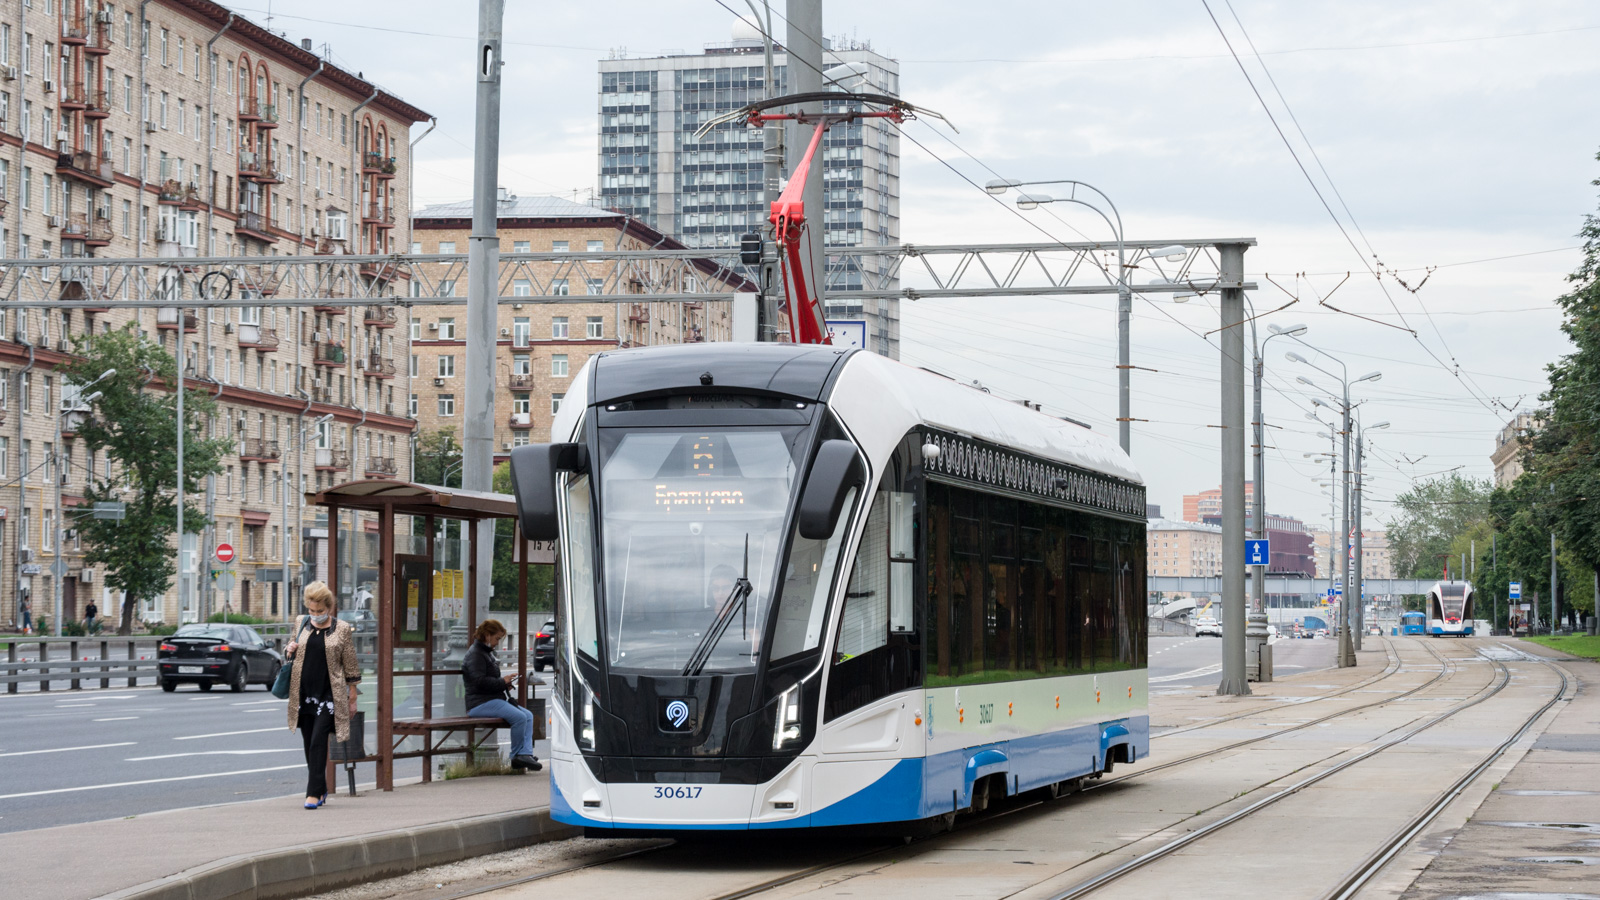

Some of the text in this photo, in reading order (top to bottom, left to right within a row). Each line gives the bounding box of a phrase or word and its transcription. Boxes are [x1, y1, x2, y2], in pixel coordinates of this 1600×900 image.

[693, 436, 714, 476] 6
[979, 703, 994, 725] 30617
[654, 786, 703, 799] 30617
